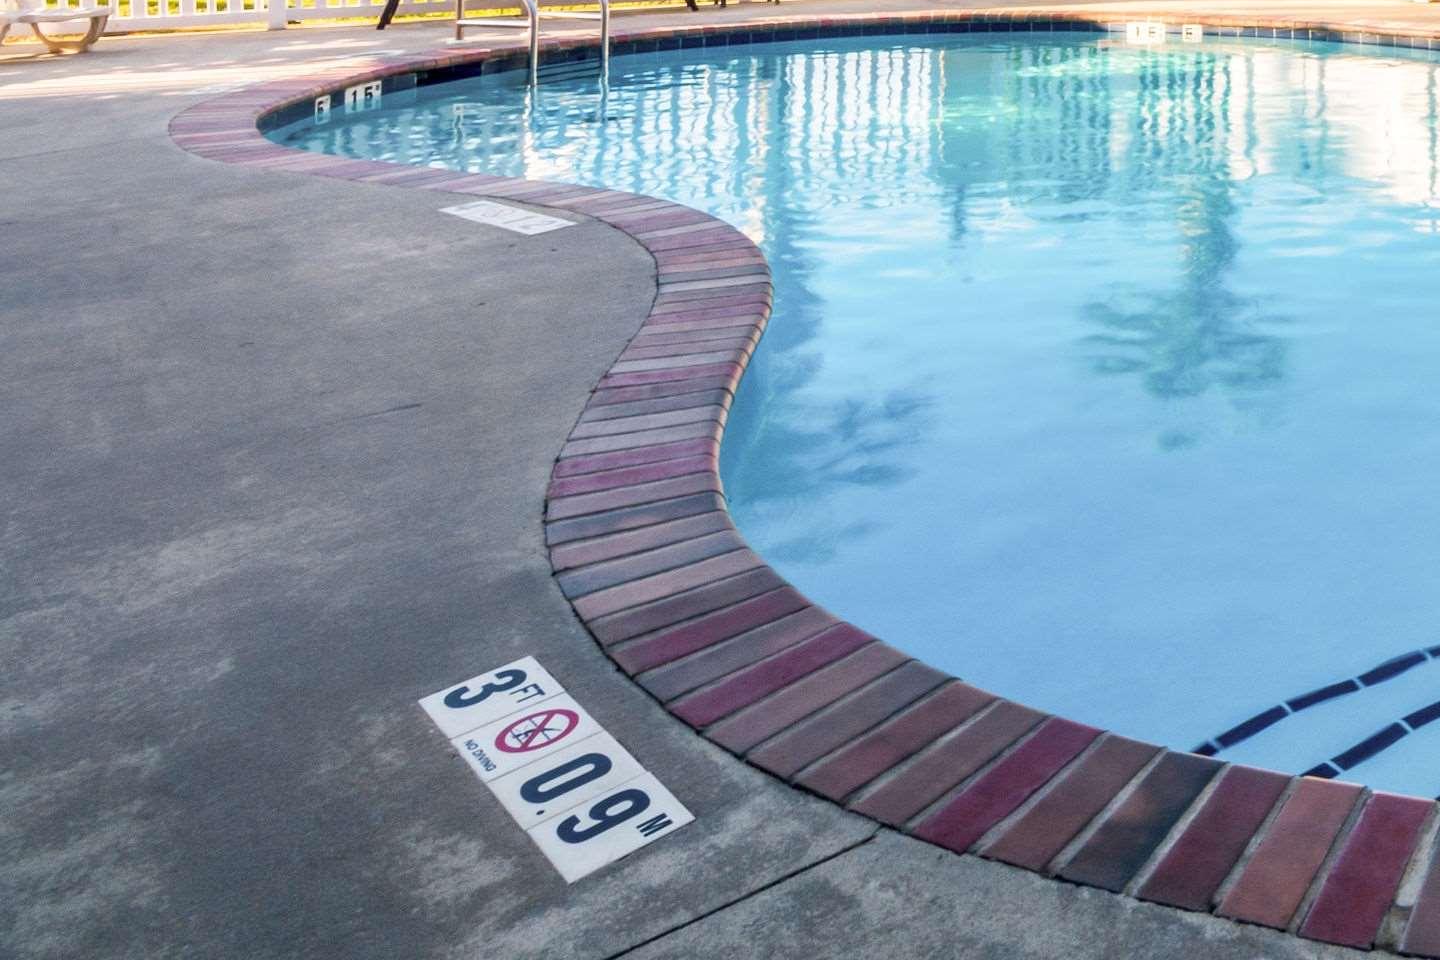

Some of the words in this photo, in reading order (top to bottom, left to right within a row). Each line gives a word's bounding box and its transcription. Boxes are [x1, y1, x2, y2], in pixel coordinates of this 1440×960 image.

[443, 668, 528, 709] 3
[509, 683, 546, 703] FT
[464, 739, 479, 751] NO
[471, 749, 497, 772] DIVING
